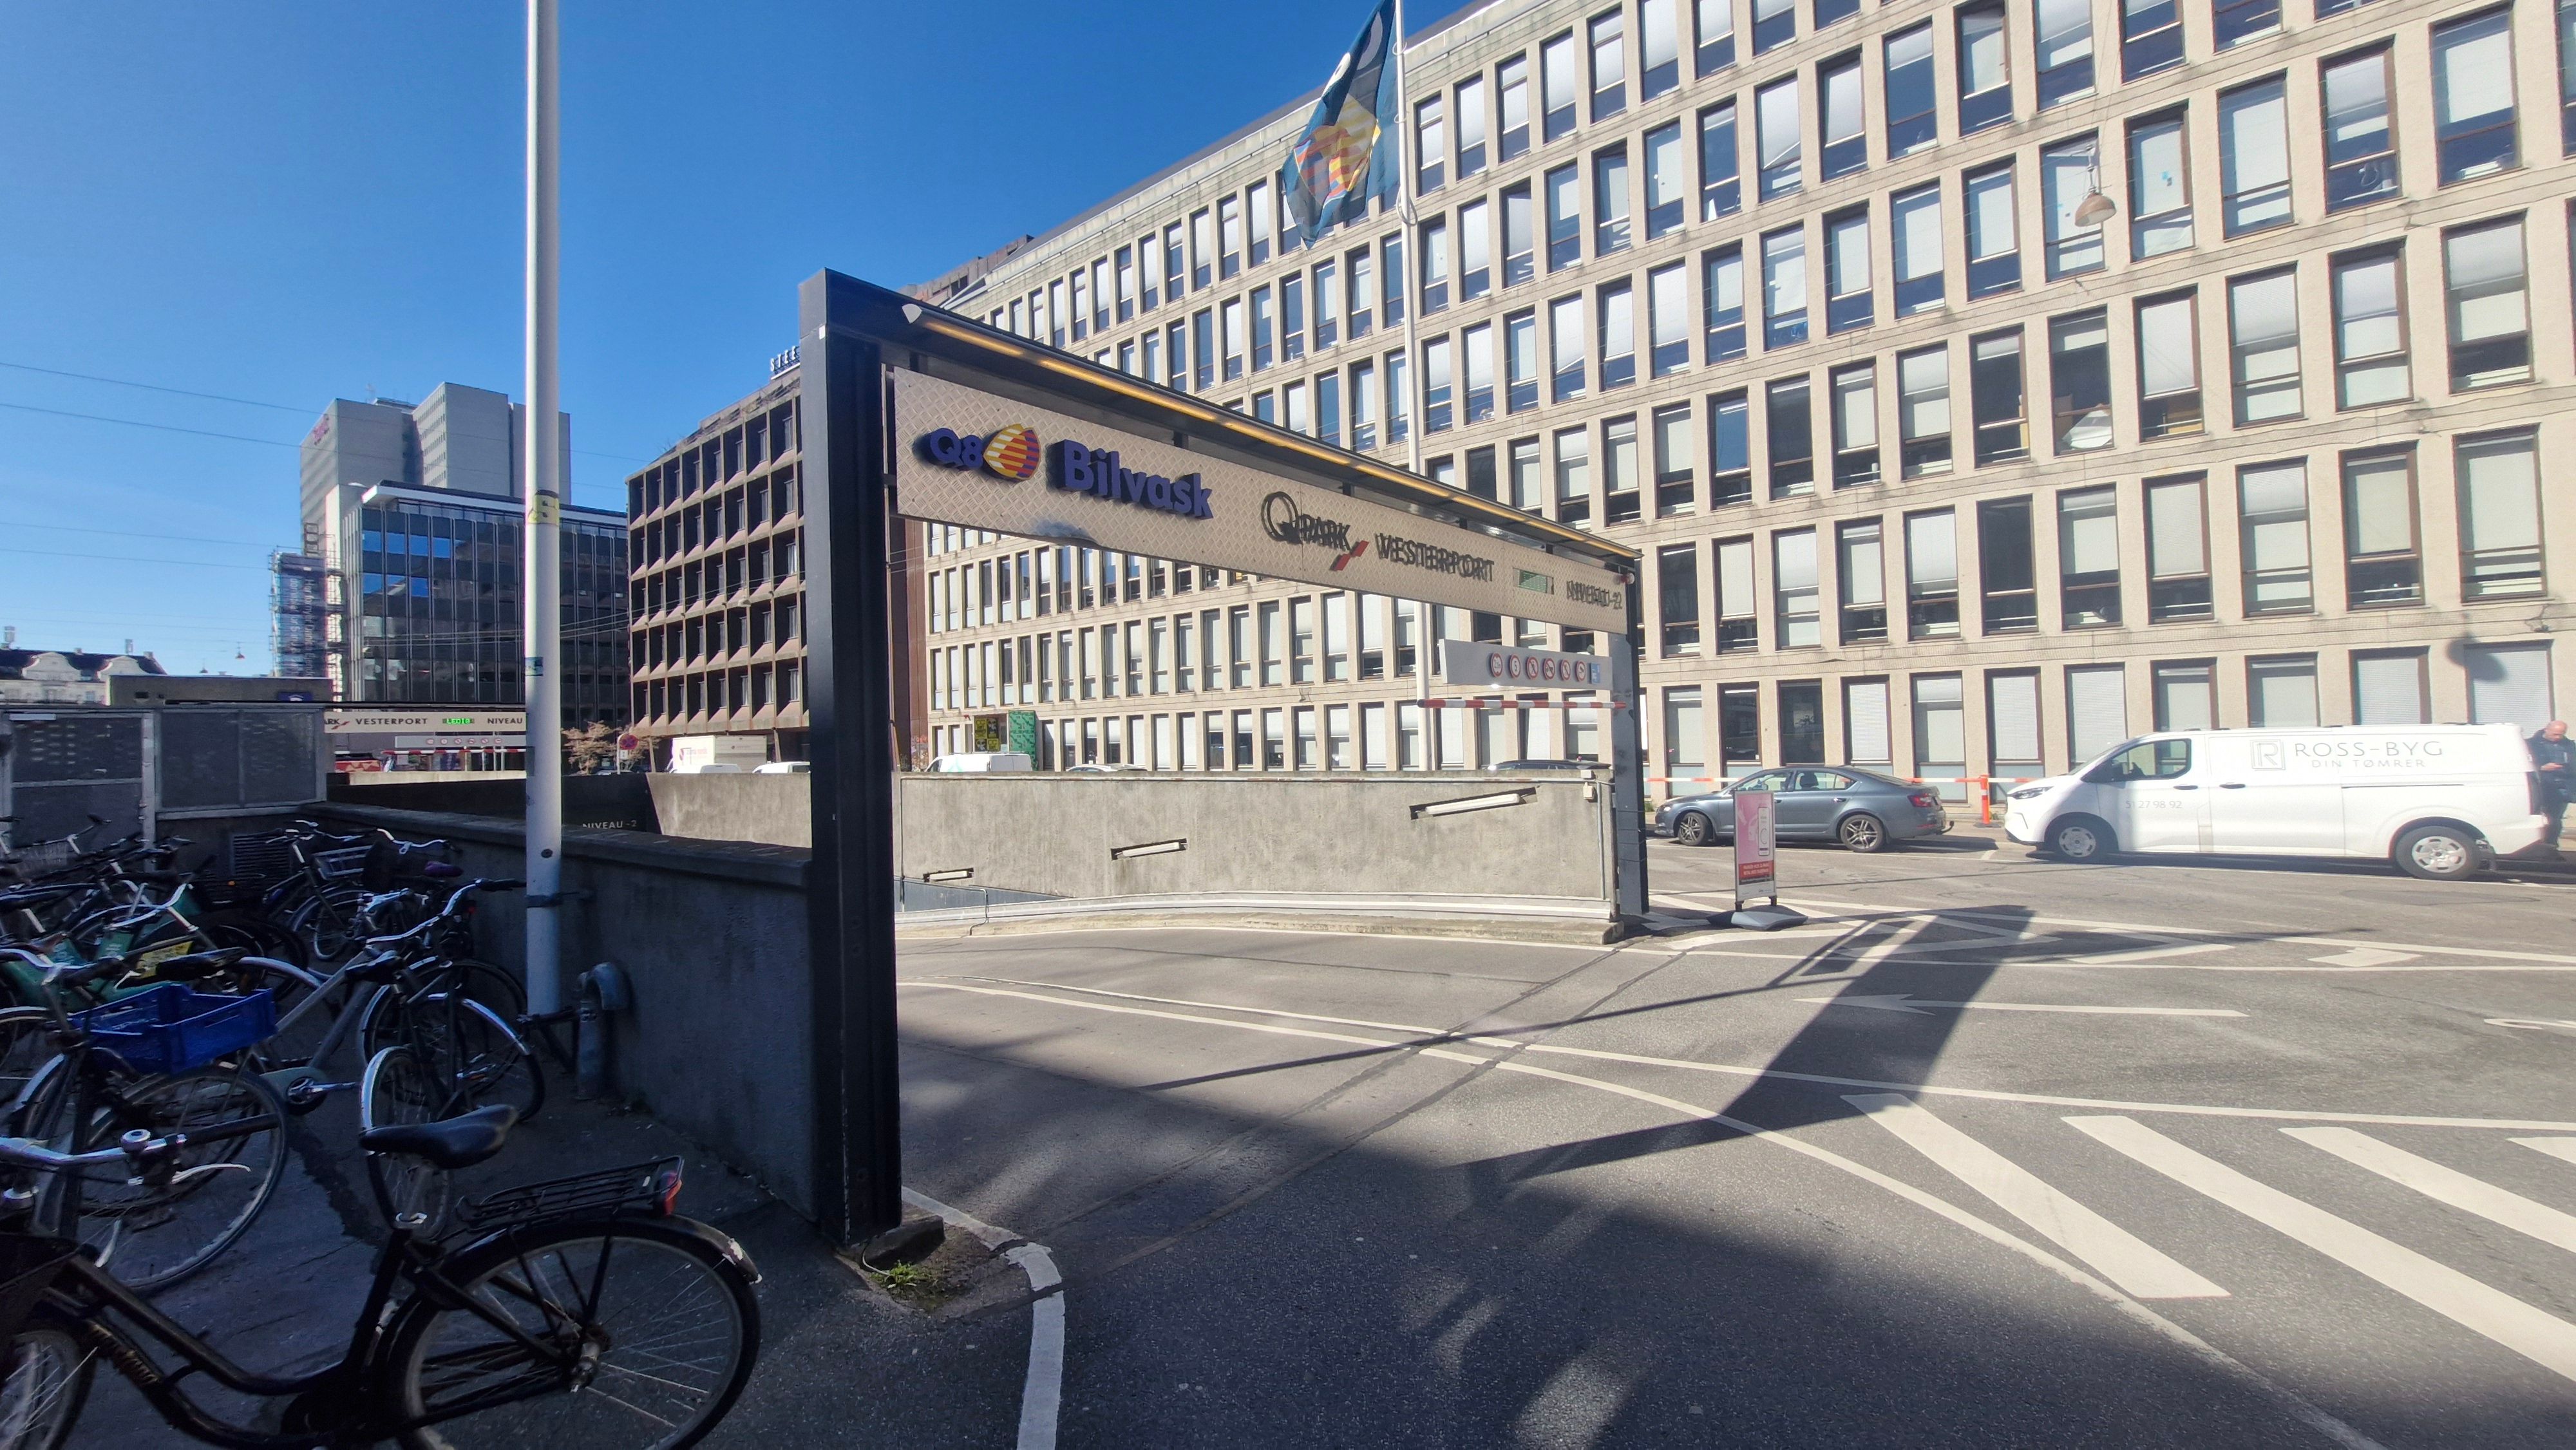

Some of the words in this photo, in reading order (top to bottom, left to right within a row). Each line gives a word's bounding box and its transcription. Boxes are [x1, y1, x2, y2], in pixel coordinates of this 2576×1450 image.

[926, 428, 983, 470] Q8
[1060, 439, 1213, 519] Bilvask
[2295, 741, 2443, 757] ROSS-BYG
[2353, 759, 2426, 768] TØMRER
[2139, 800, 2150, 809] 27
[2168, 800, 2183, 809] 92
